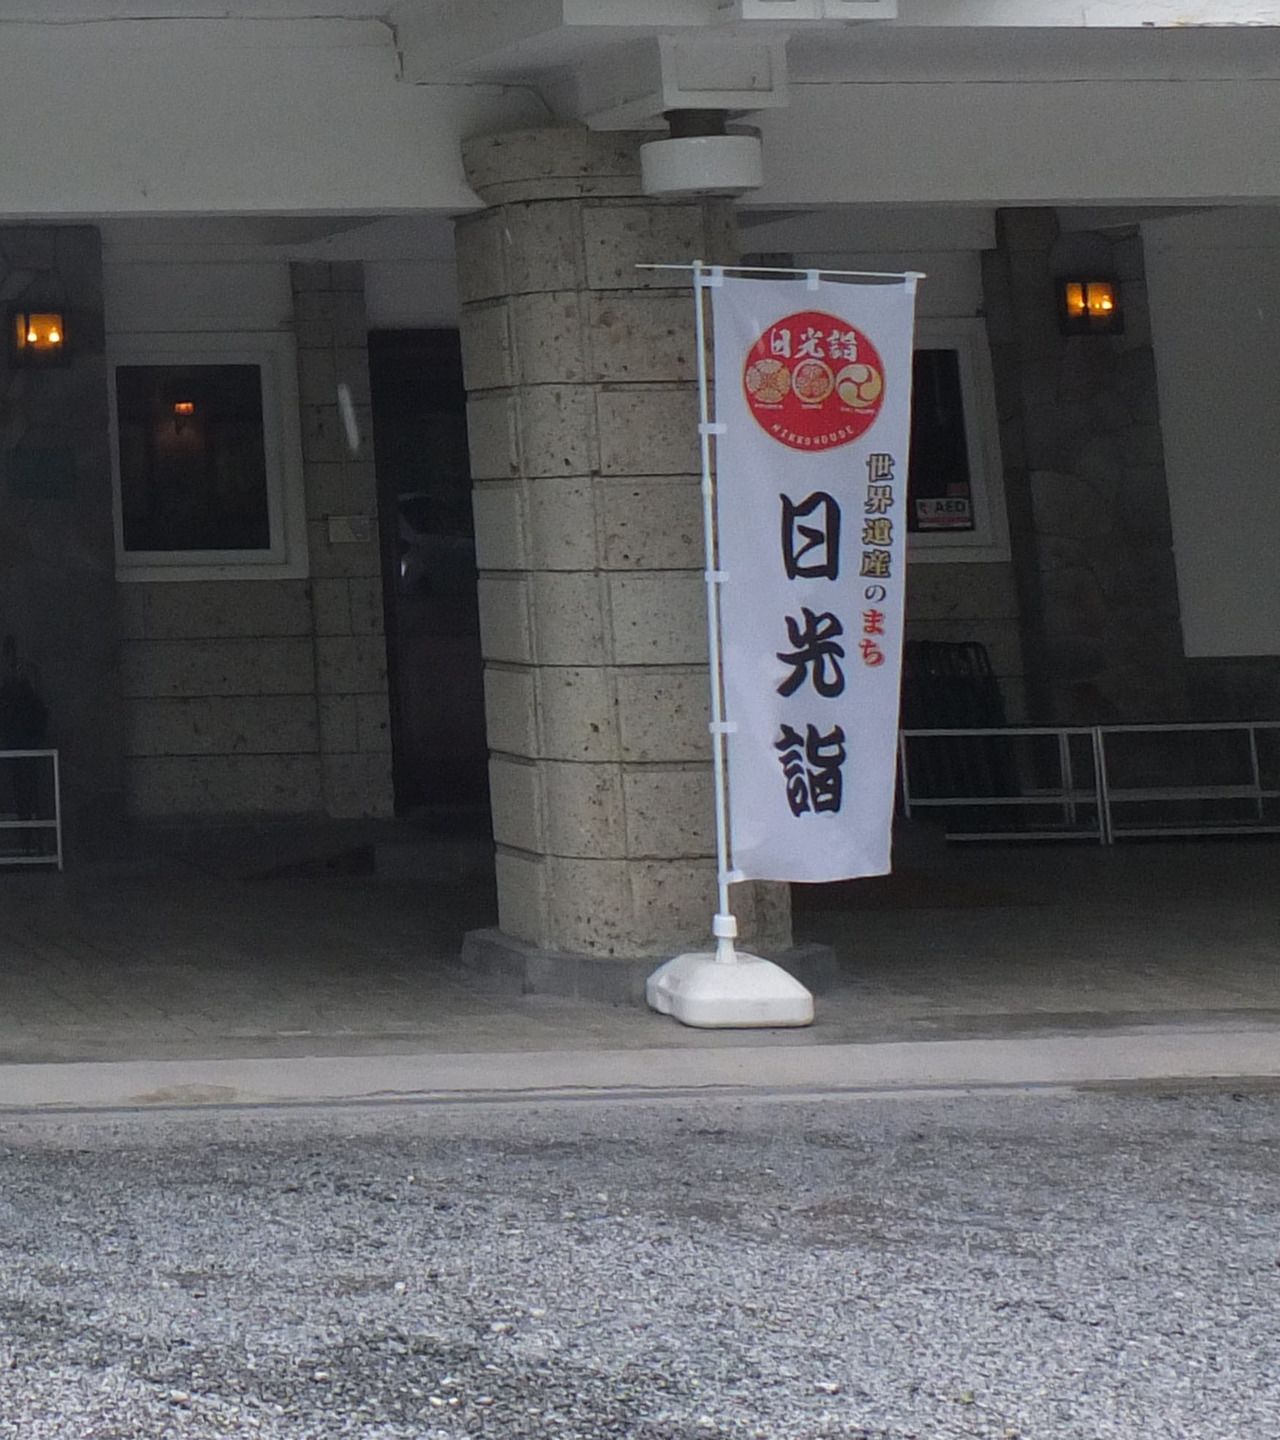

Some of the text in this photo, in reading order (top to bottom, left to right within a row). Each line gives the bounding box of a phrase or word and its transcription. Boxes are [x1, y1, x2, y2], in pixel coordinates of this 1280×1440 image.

[770, 327, 858, 362] 日光詣
[859, 453, 895, 667] 世界遺産のまち
[935, 501, 966, 513] AED
[775, 491, 847, 818] 日光詣
